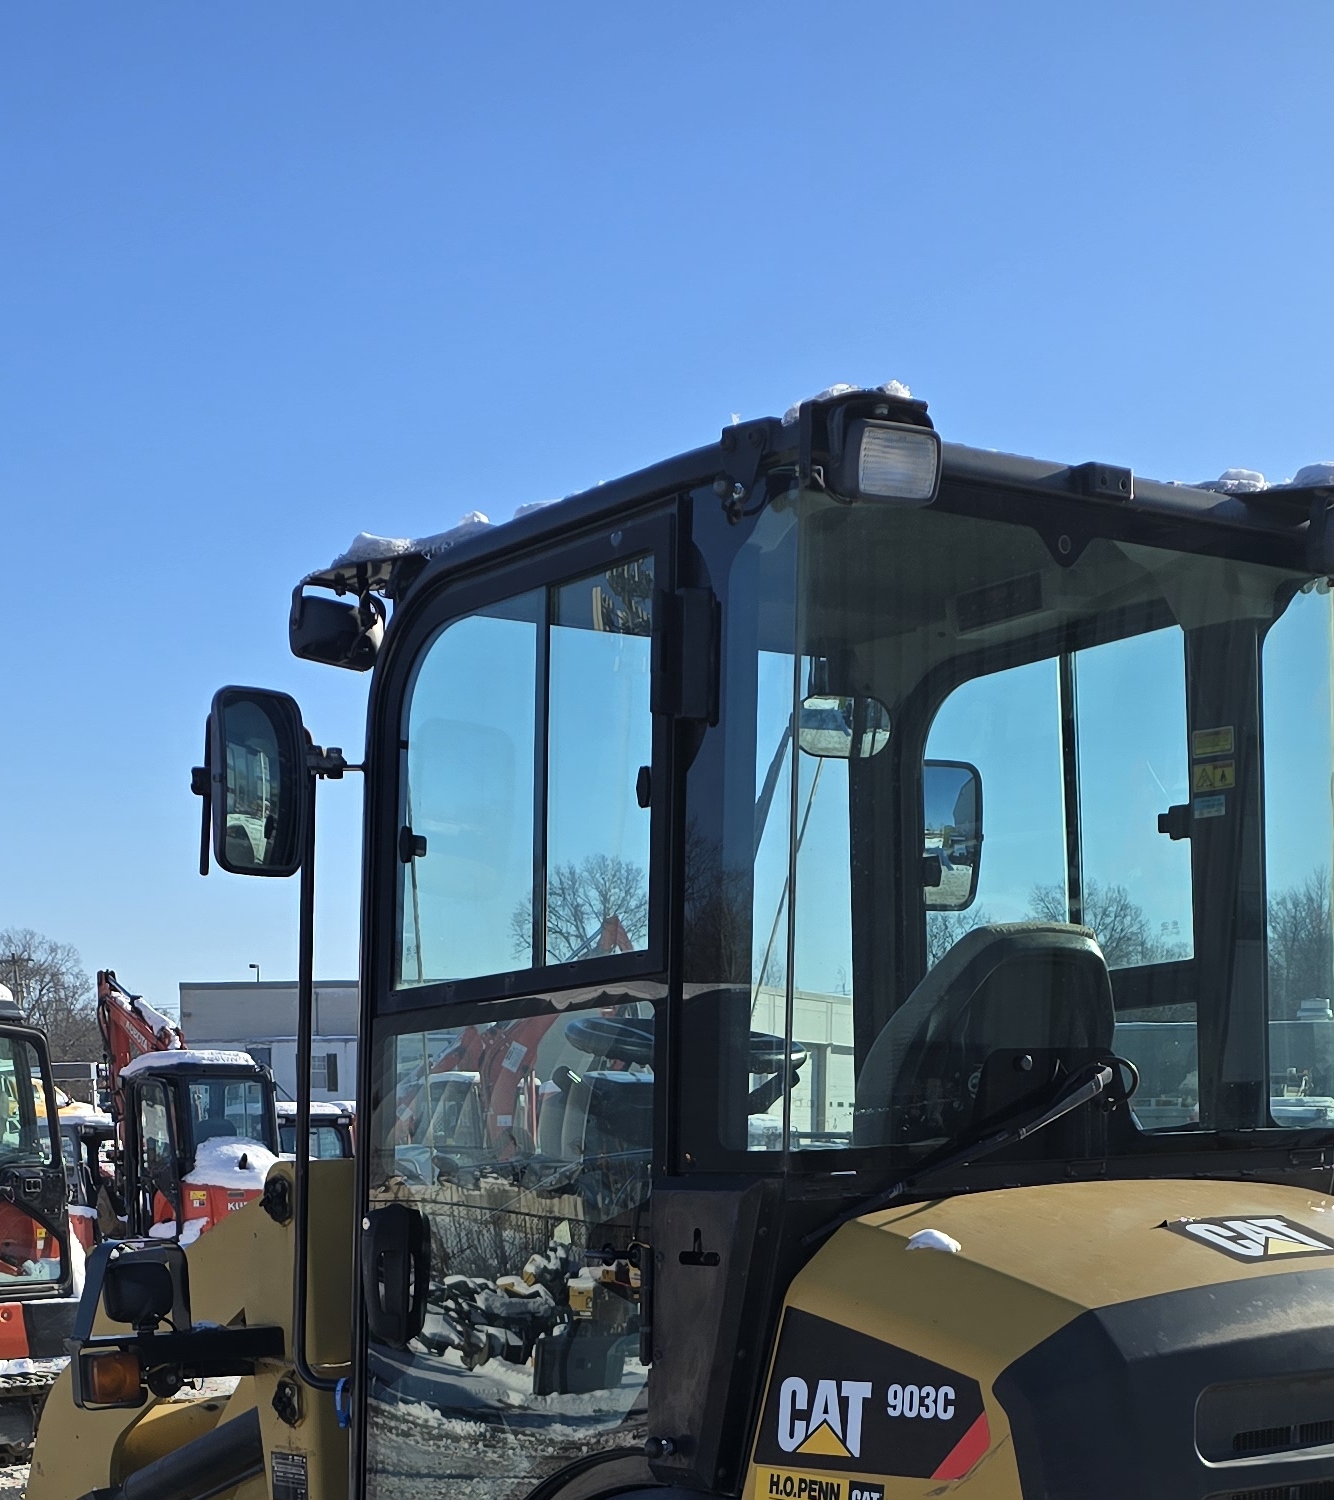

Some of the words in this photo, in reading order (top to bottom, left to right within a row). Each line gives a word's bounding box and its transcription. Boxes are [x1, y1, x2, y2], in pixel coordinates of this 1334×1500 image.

[1185, 1218, 1334, 1257] CAT
[777, 1376, 873, 1458] CAT
[886, 1383, 956, 1421] 903C
